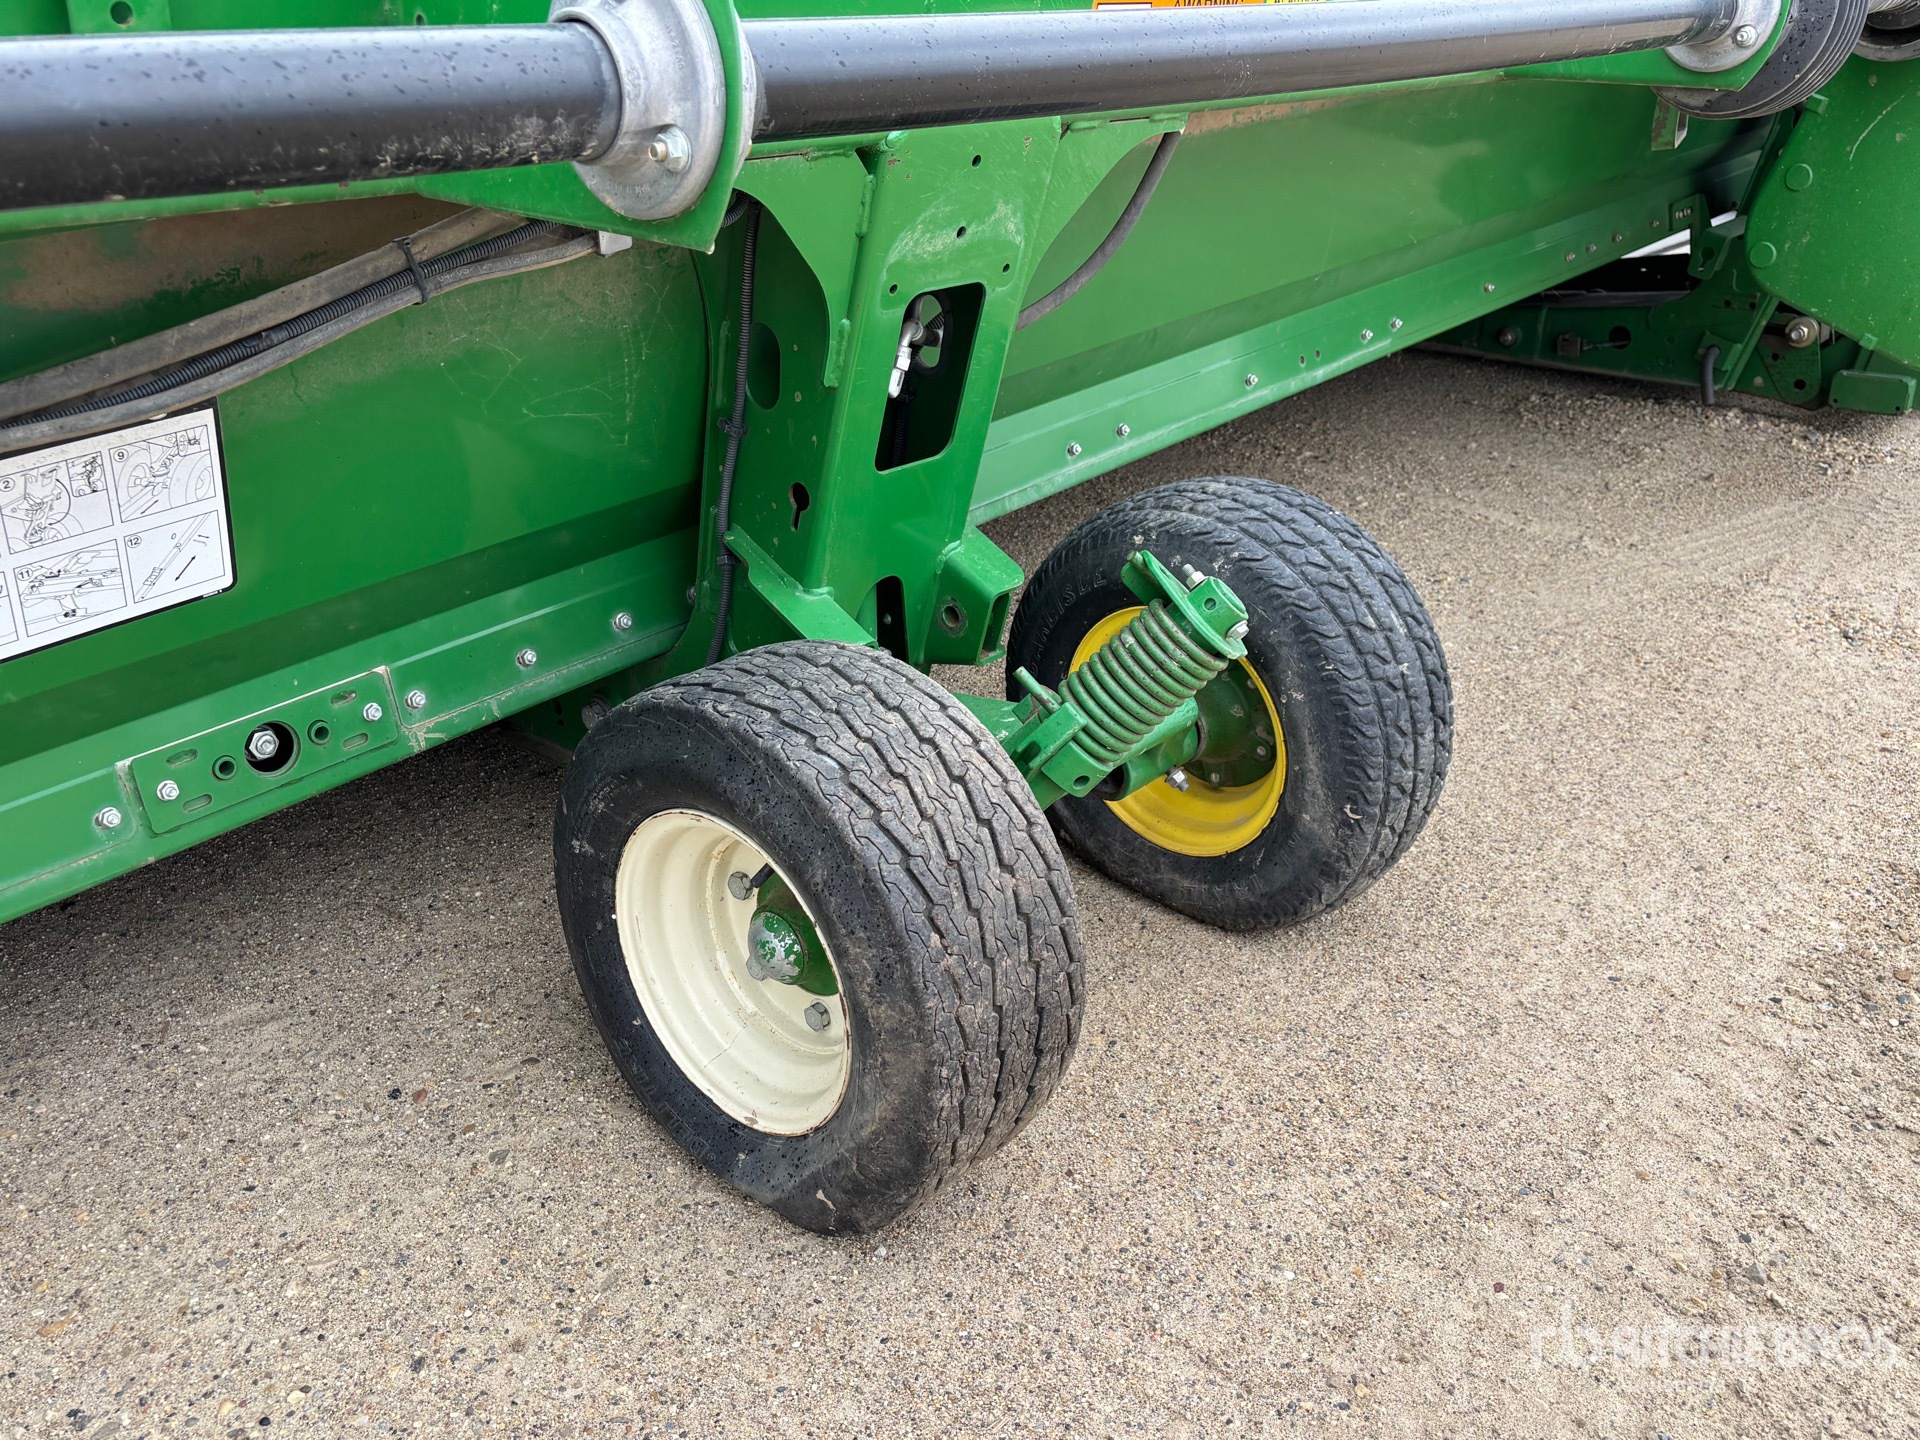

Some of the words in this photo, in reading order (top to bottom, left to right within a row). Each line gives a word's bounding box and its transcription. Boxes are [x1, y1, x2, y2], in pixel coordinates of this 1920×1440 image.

[117, 451, 125, 460] 9
[2, 480, 10, 490] 2
[129, 537, 140, 547] 12
[18, 569, 30, 580] 11
